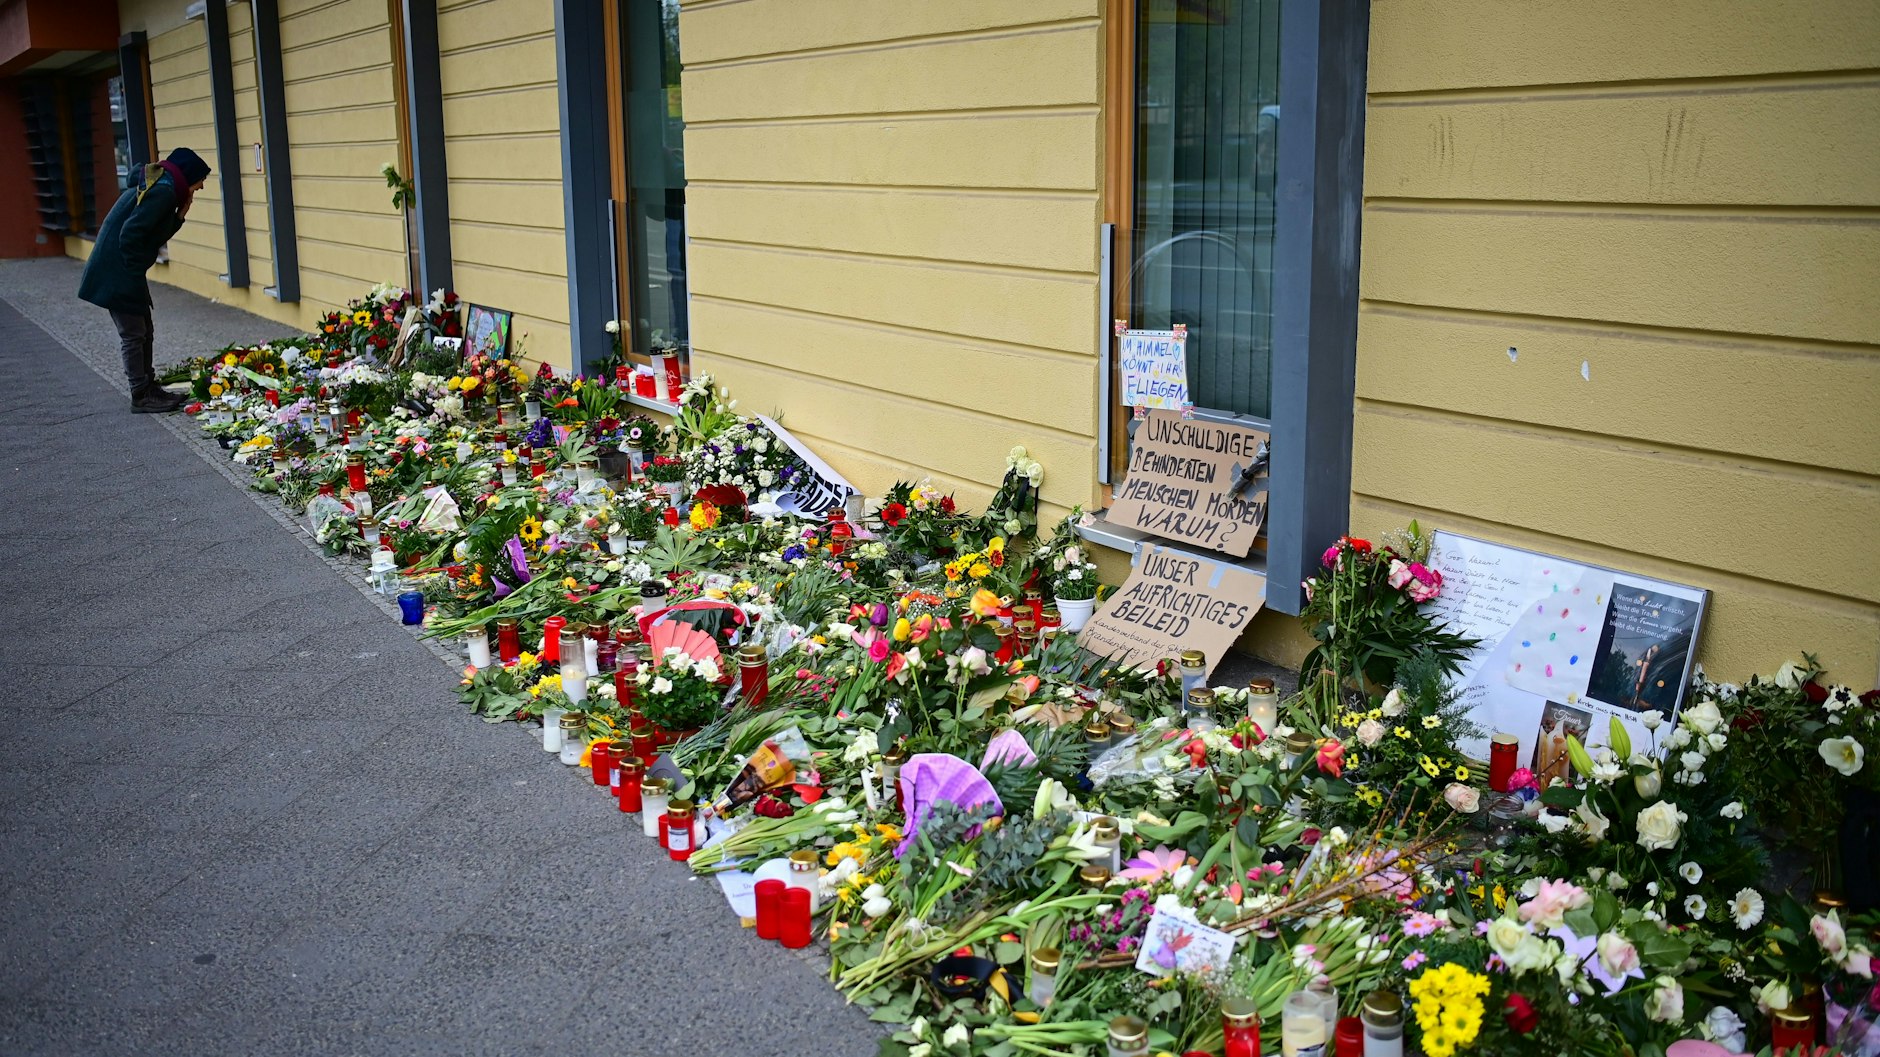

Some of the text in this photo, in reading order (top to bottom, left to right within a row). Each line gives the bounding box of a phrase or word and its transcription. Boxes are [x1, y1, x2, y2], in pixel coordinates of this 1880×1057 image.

[1122, 338, 1172, 357] IM HIMMEL
[1123, 354, 1180, 377] KÖNNT IHR
[1127, 375, 1188, 401] FLIEGEN
[1147, 415, 1255, 458] UNSCHULDIGE
[1131, 446, 1216, 484] BEHINDERTEN
[1121, 478, 1199, 511] MENSCHEN
[1143, 553, 1200, 586] UNSER
[1124, 581, 1249, 629] AUFRICHTIGES
[1614, 602, 1630, 612] bleibt
[1616, 594, 1633, 603] Wenn
[1644, 600, 1663, 610] Licht
[1110, 600, 1190, 638] BEILEID
[1612, 611, 1628, 620] Wenn
[1086, 627, 1140, 660] Brandenburg
[1609, 620, 1626, 629] bleibt
[1635, 627, 1669, 641] Erinnerung.
[1554, 709, 1581, 726] Trauer
